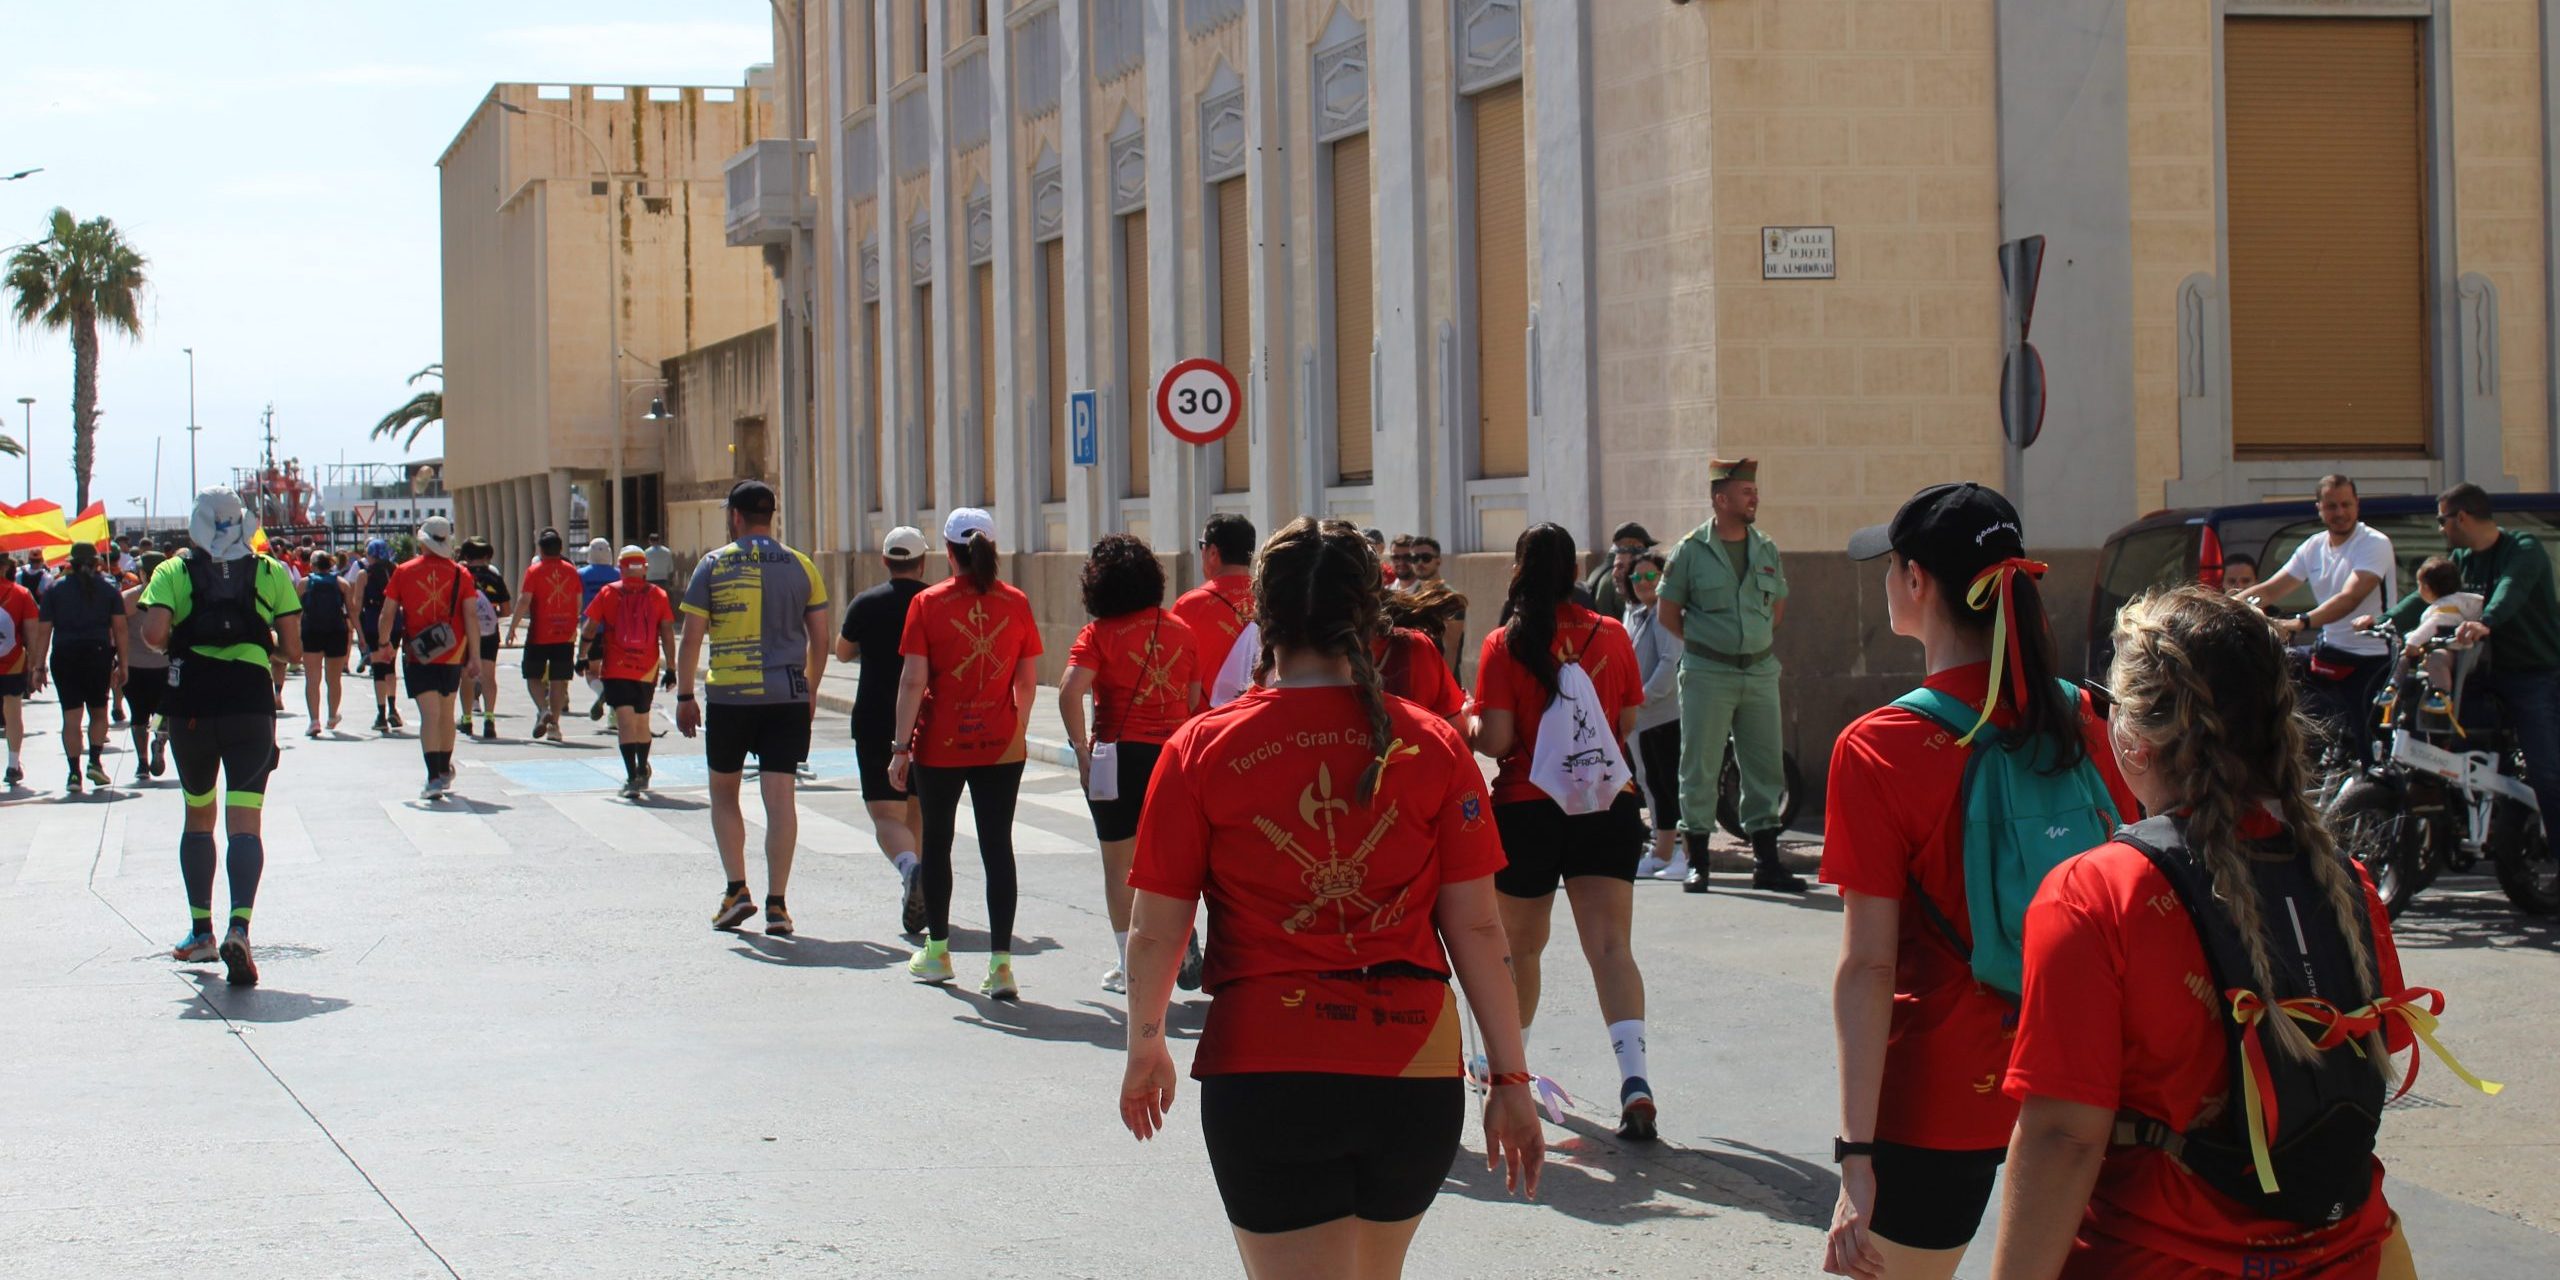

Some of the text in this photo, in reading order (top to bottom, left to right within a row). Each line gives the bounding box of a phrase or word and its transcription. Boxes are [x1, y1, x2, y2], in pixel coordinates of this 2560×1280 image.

[1178, 388, 1223, 415] 30
[1975, 521, 2000, 547] good
[1228, 740, 1282, 775] Tercio
[1286, 730, 1339, 748] “Gran
